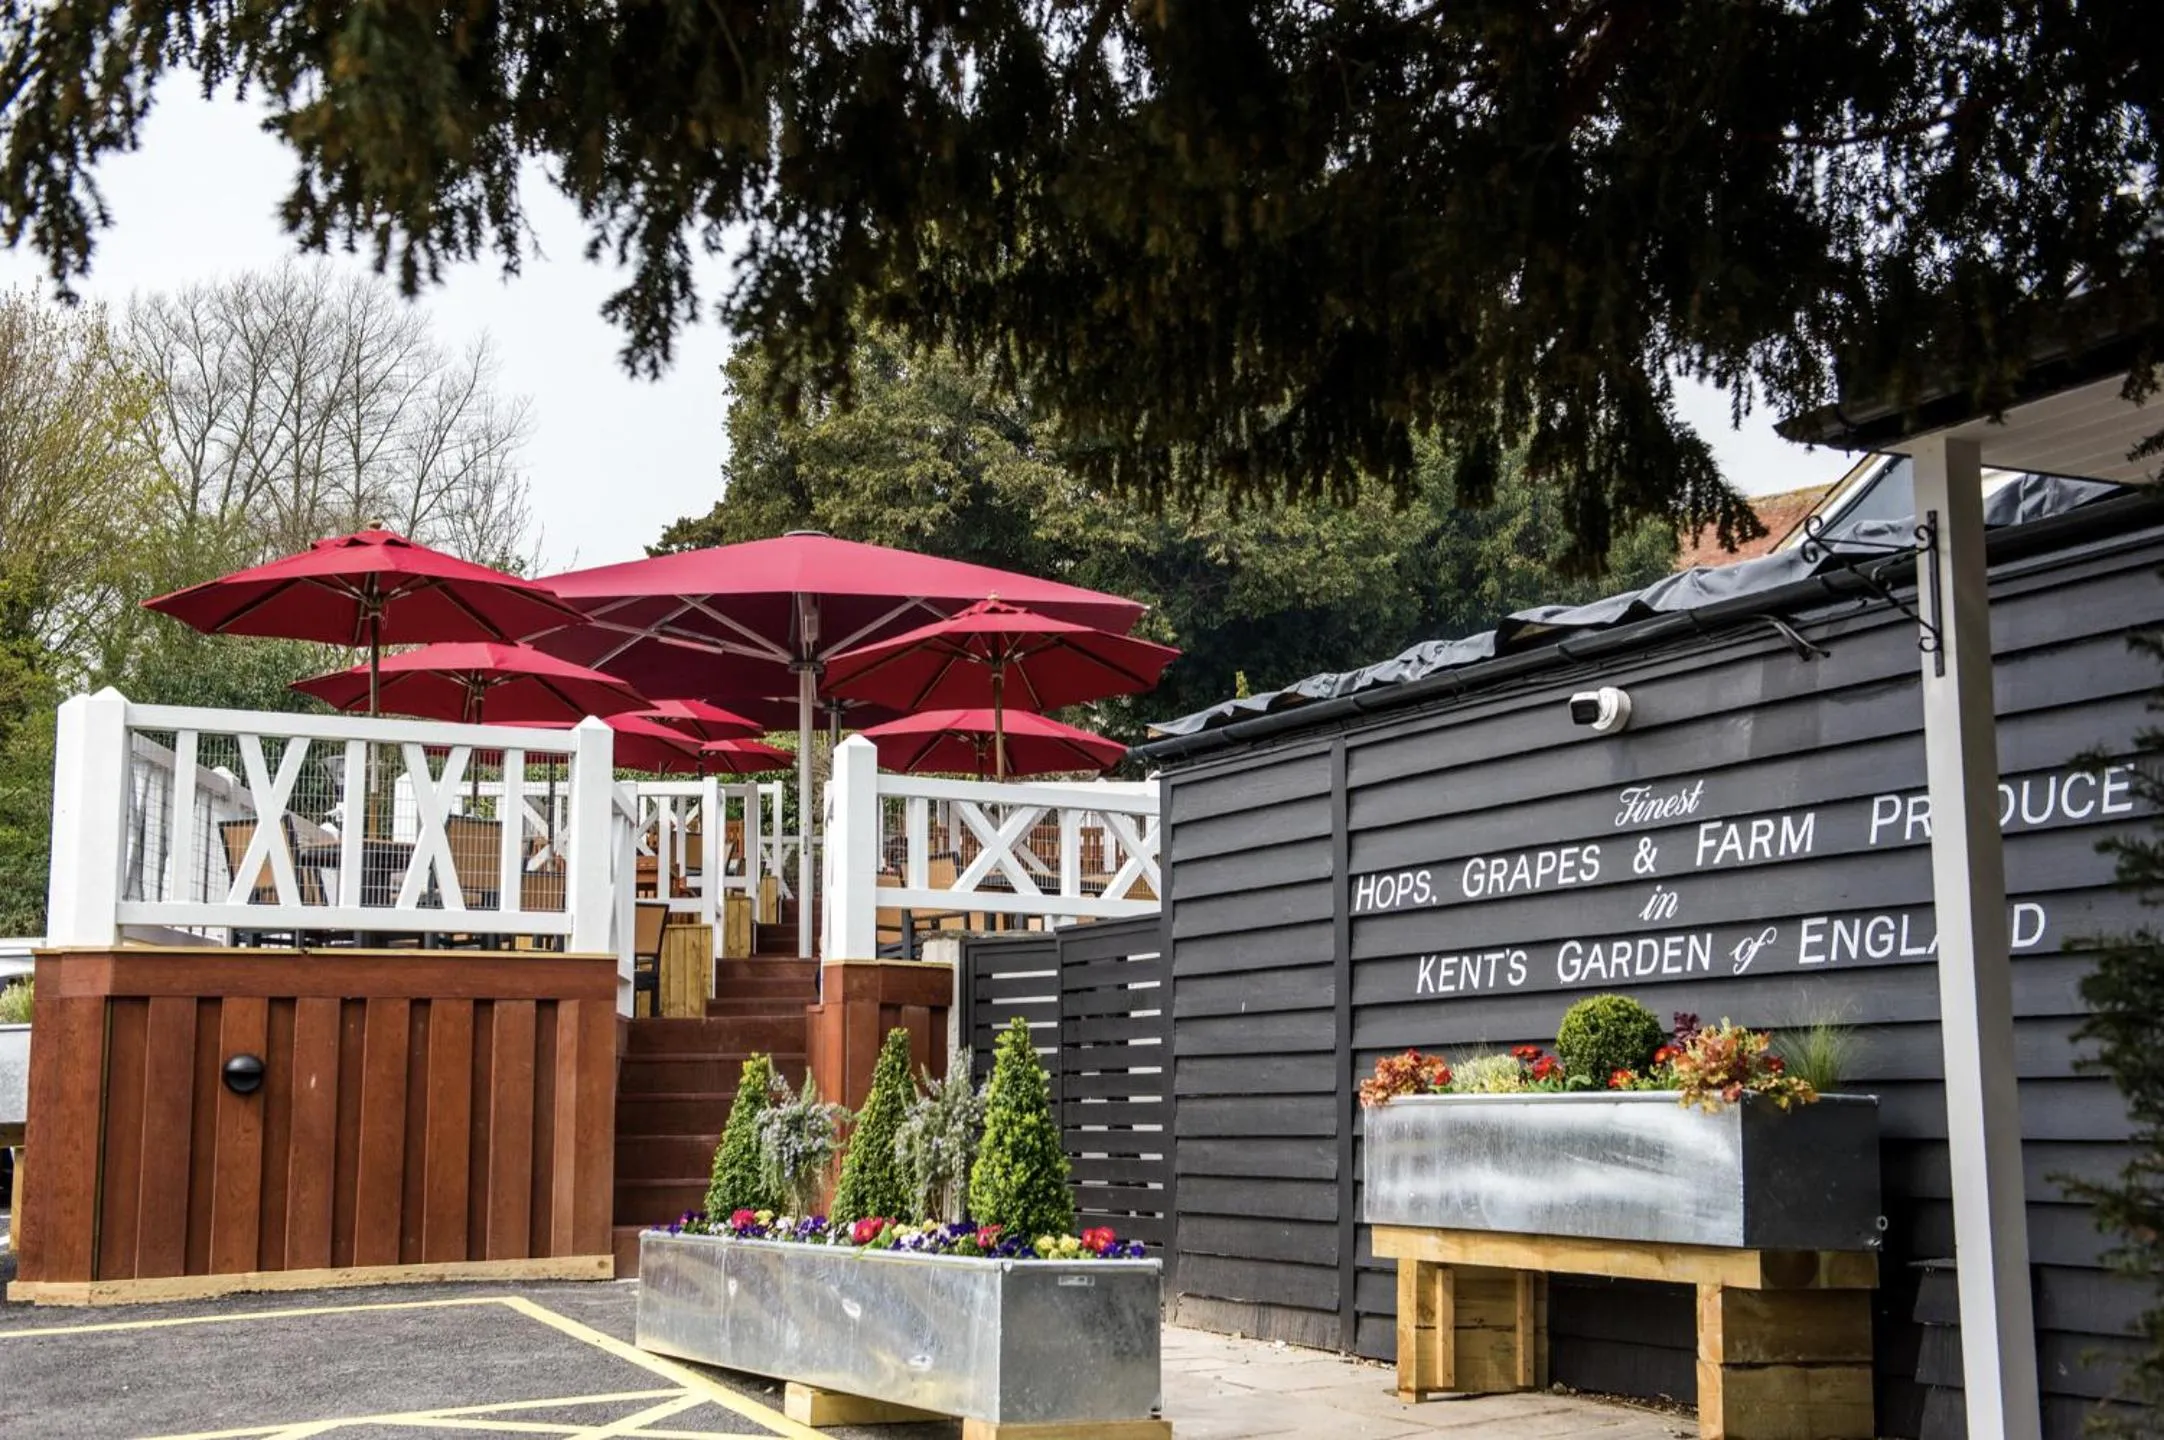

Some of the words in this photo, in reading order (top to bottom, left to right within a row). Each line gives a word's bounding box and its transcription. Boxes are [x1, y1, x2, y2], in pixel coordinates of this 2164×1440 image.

[1462, 845, 1601, 898] GRAPES
[1632, 836, 1659, 875] &
[1695, 812, 1816, 867] FARM
[1869, 763, 2135, 845] PRDUCE
[1615, 779, 1704, 827] Finest
[1638, 884, 1679, 922] in
[1416, 948, 1528, 995] KENT'S
[1557, 932, 1713, 985] GARDEN
[1728, 926, 1777, 976] of
[1798, 902, 2046, 965] ENGLD
